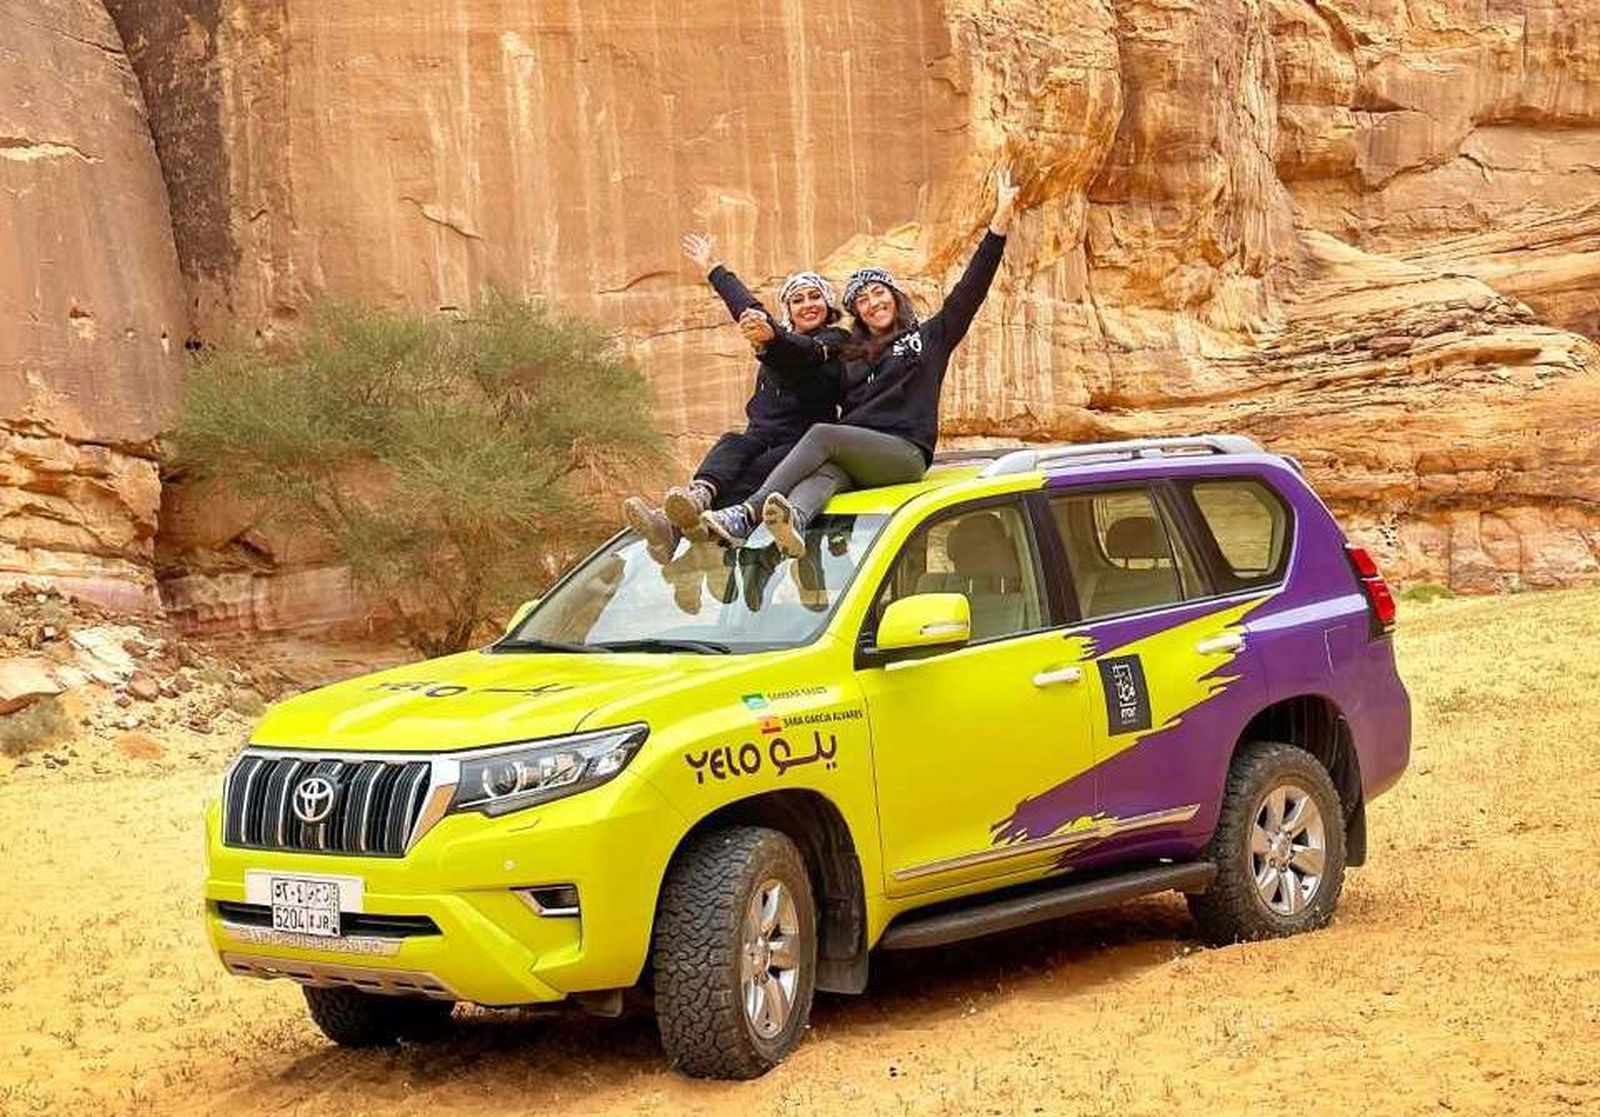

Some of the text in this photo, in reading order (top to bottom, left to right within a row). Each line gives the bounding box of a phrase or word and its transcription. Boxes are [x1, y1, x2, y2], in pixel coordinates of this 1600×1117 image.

[685, 743, 761, 784] YELO
[769, 731, 837, 776] يلو
[275, 907, 304, 929] 5204
